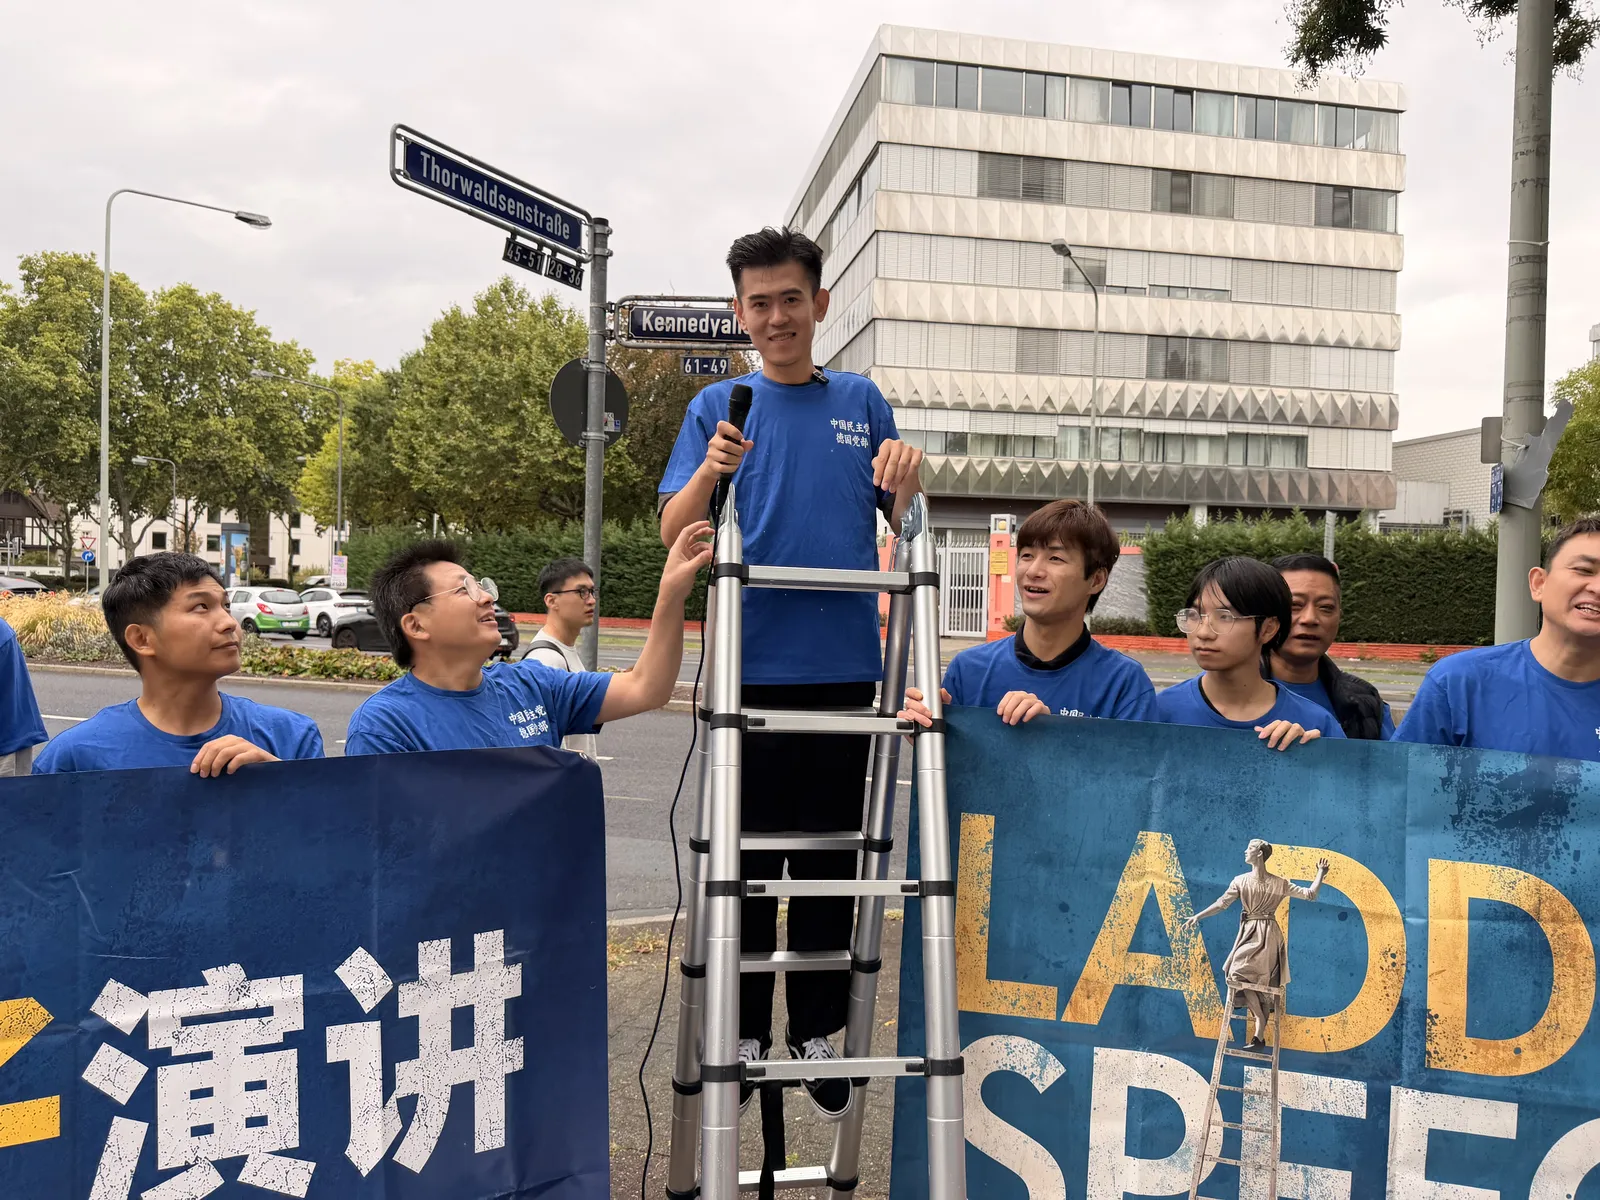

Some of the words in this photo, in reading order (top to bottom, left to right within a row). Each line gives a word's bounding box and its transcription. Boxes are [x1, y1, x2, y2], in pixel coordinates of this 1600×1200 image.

[420, 151, 571, 240] Thorwaldsenstraße
[507, 243, 541, 271] 45-51
[549, 260, 581, 286] 28-36
[642, 310, 750, 338] Kennedyall
[684, 358, 727, 374] 61-49
[954, 812, 1597, 1076] LADD
